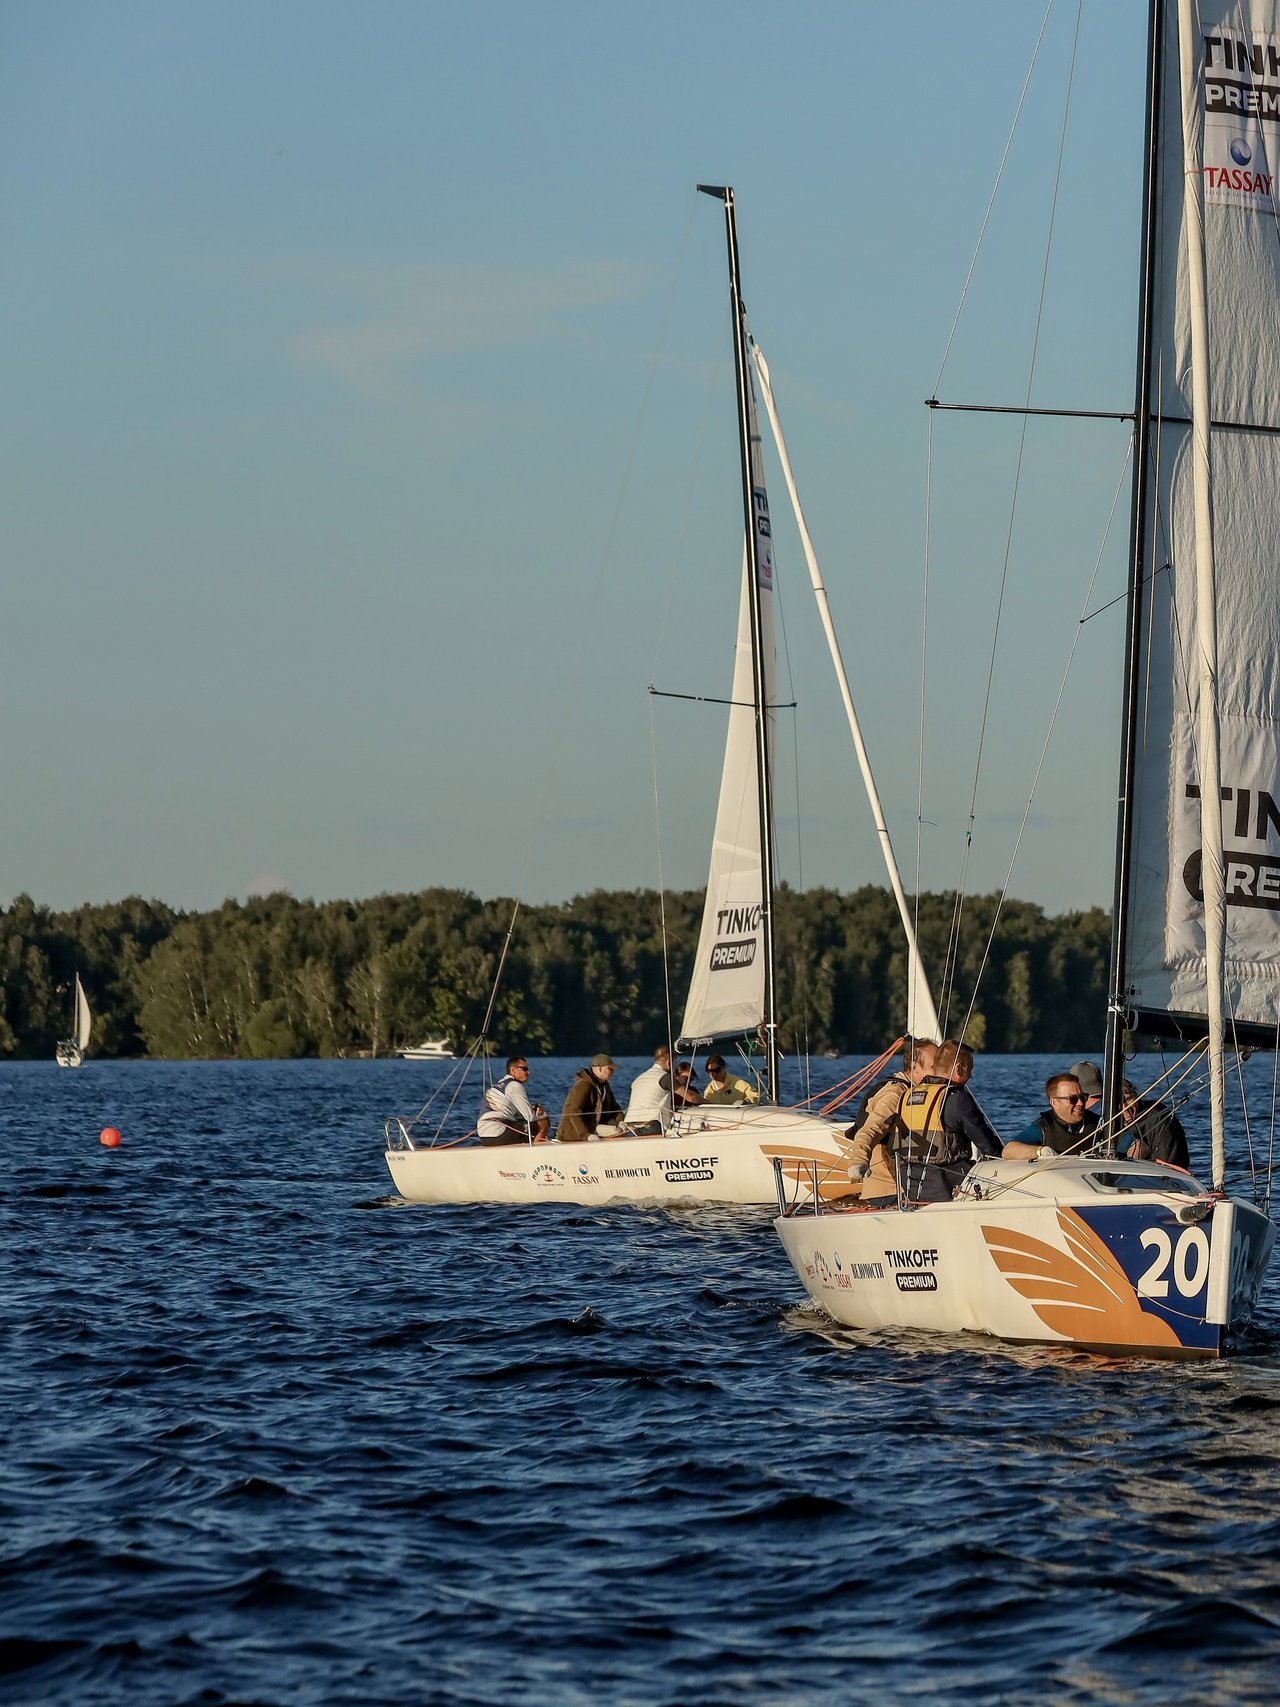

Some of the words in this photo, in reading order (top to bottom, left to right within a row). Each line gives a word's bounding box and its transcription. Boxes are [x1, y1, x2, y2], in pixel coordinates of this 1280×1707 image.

[1205, 167, 1275, 196] TASSAY
[717, 903, 764, 936] TINKO
[655, 1157, 719, 1171] TINKOFF
[571, 1176, 600, 1185] TASSAY
[604, 1168, 651, 1179] ВЕДОМОСТИ
[667, 1171, 712, 1181] PREMIUM
[884, 1249, 939, 1268] TINKOFF
[1137, 1226, 1210, 1298] 20
[897, 1275, 936, 1288] PREMIUM
